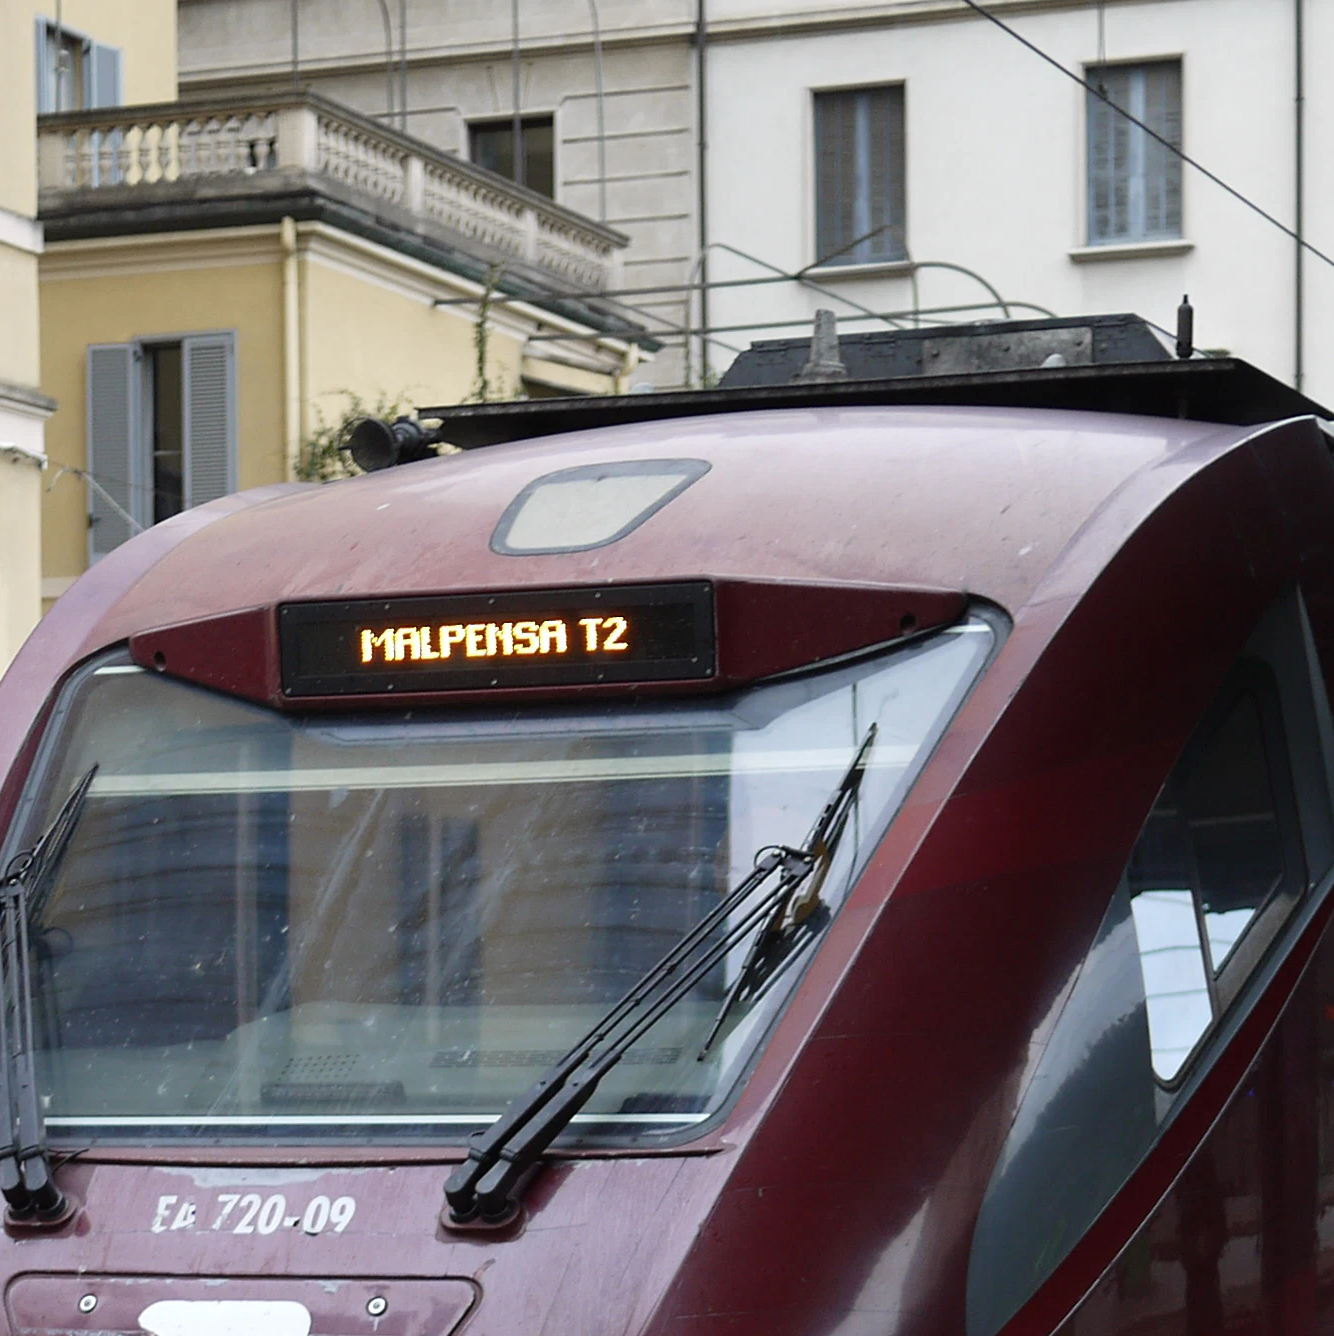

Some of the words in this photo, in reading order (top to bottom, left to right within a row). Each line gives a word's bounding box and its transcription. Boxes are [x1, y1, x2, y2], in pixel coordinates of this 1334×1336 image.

[361, 621, 568, 663] MALPENSA
[579, 616, 629, 651] T2
[211, 1193, 357, 1235] 720-09
